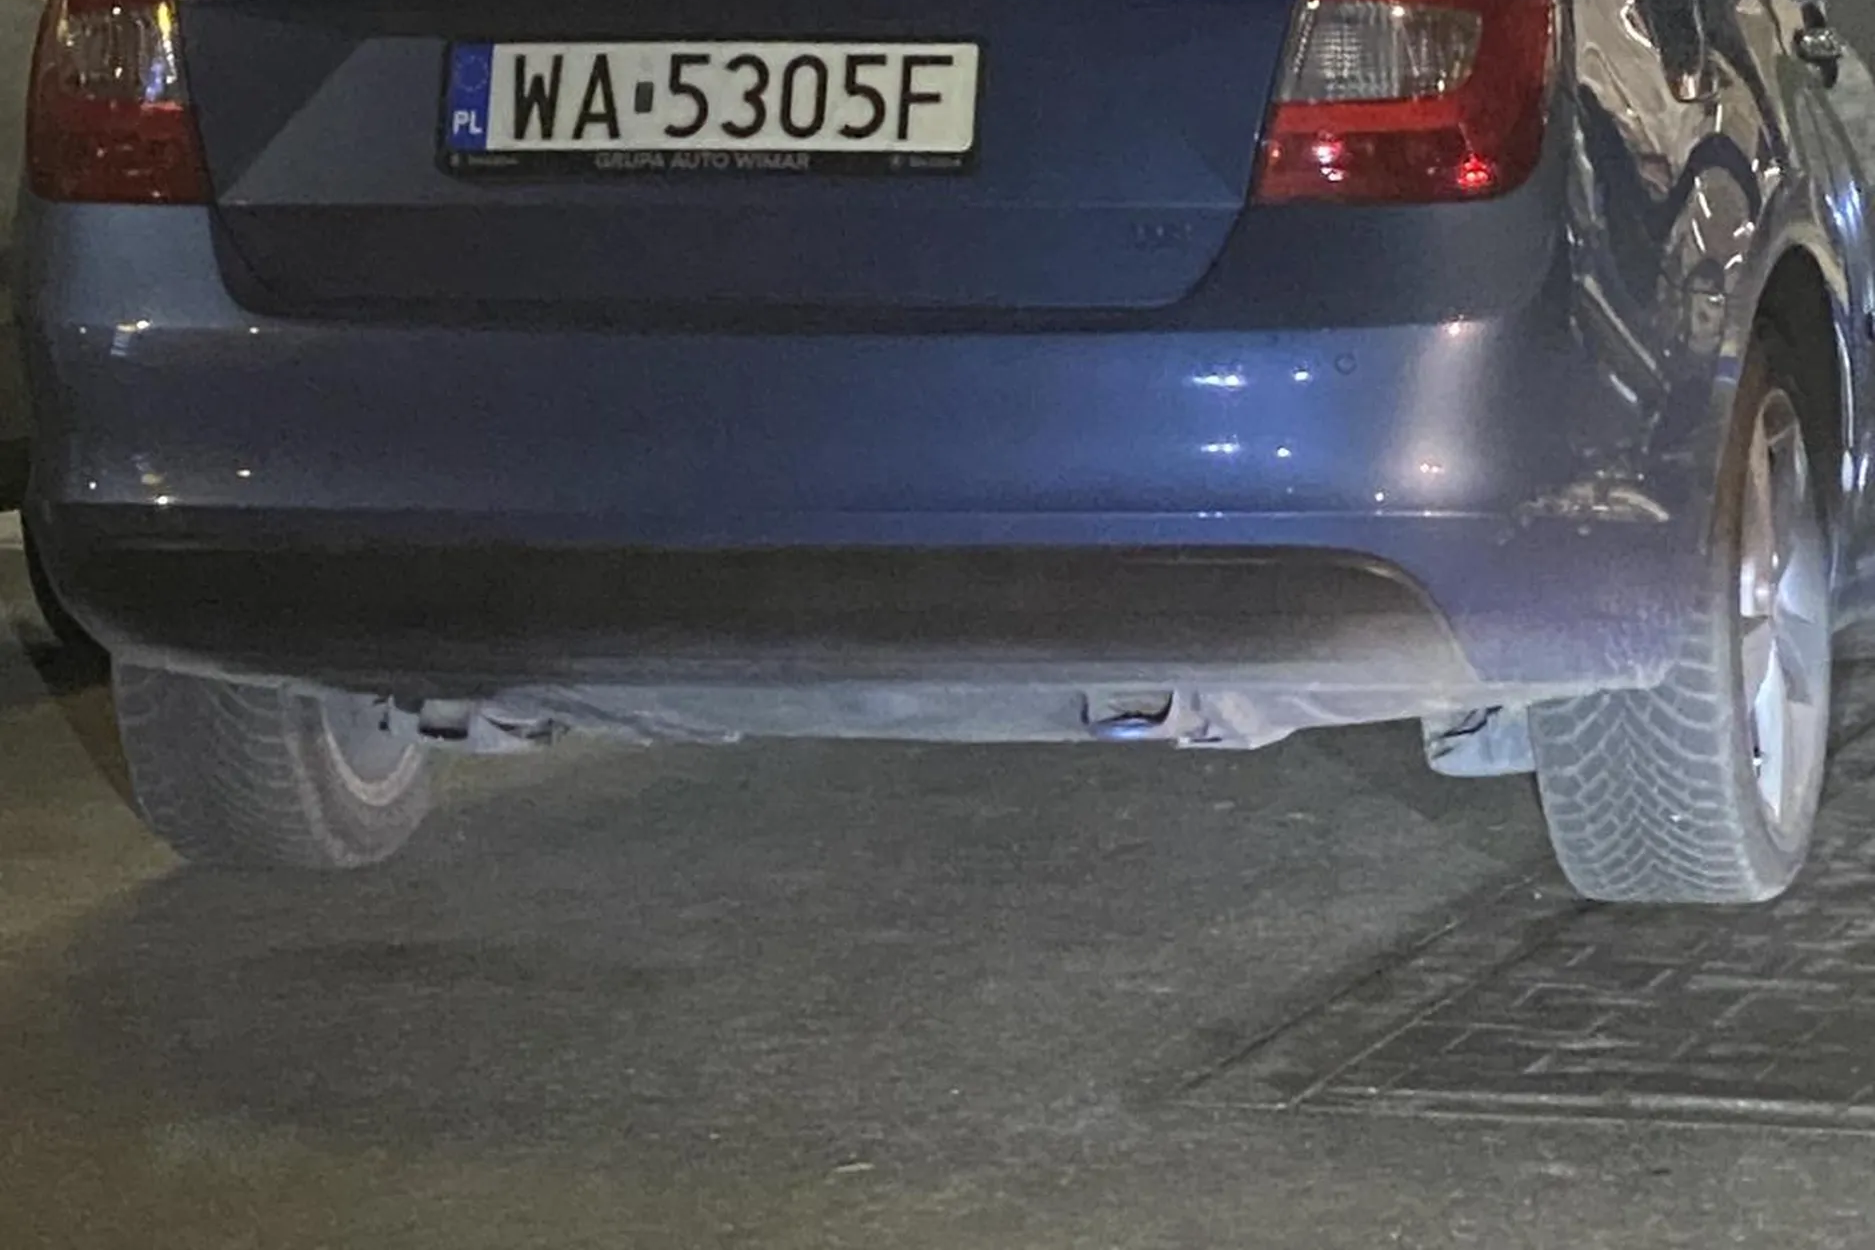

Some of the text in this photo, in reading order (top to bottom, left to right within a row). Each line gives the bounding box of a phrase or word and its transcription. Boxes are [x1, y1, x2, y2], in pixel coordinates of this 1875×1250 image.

[513, 53, 954, 141] WA 5305F
[453, 110, 483, 135] PL
[594, 152, 665, 170] GRUPA
[670, 152, 731, 170] AUTO
